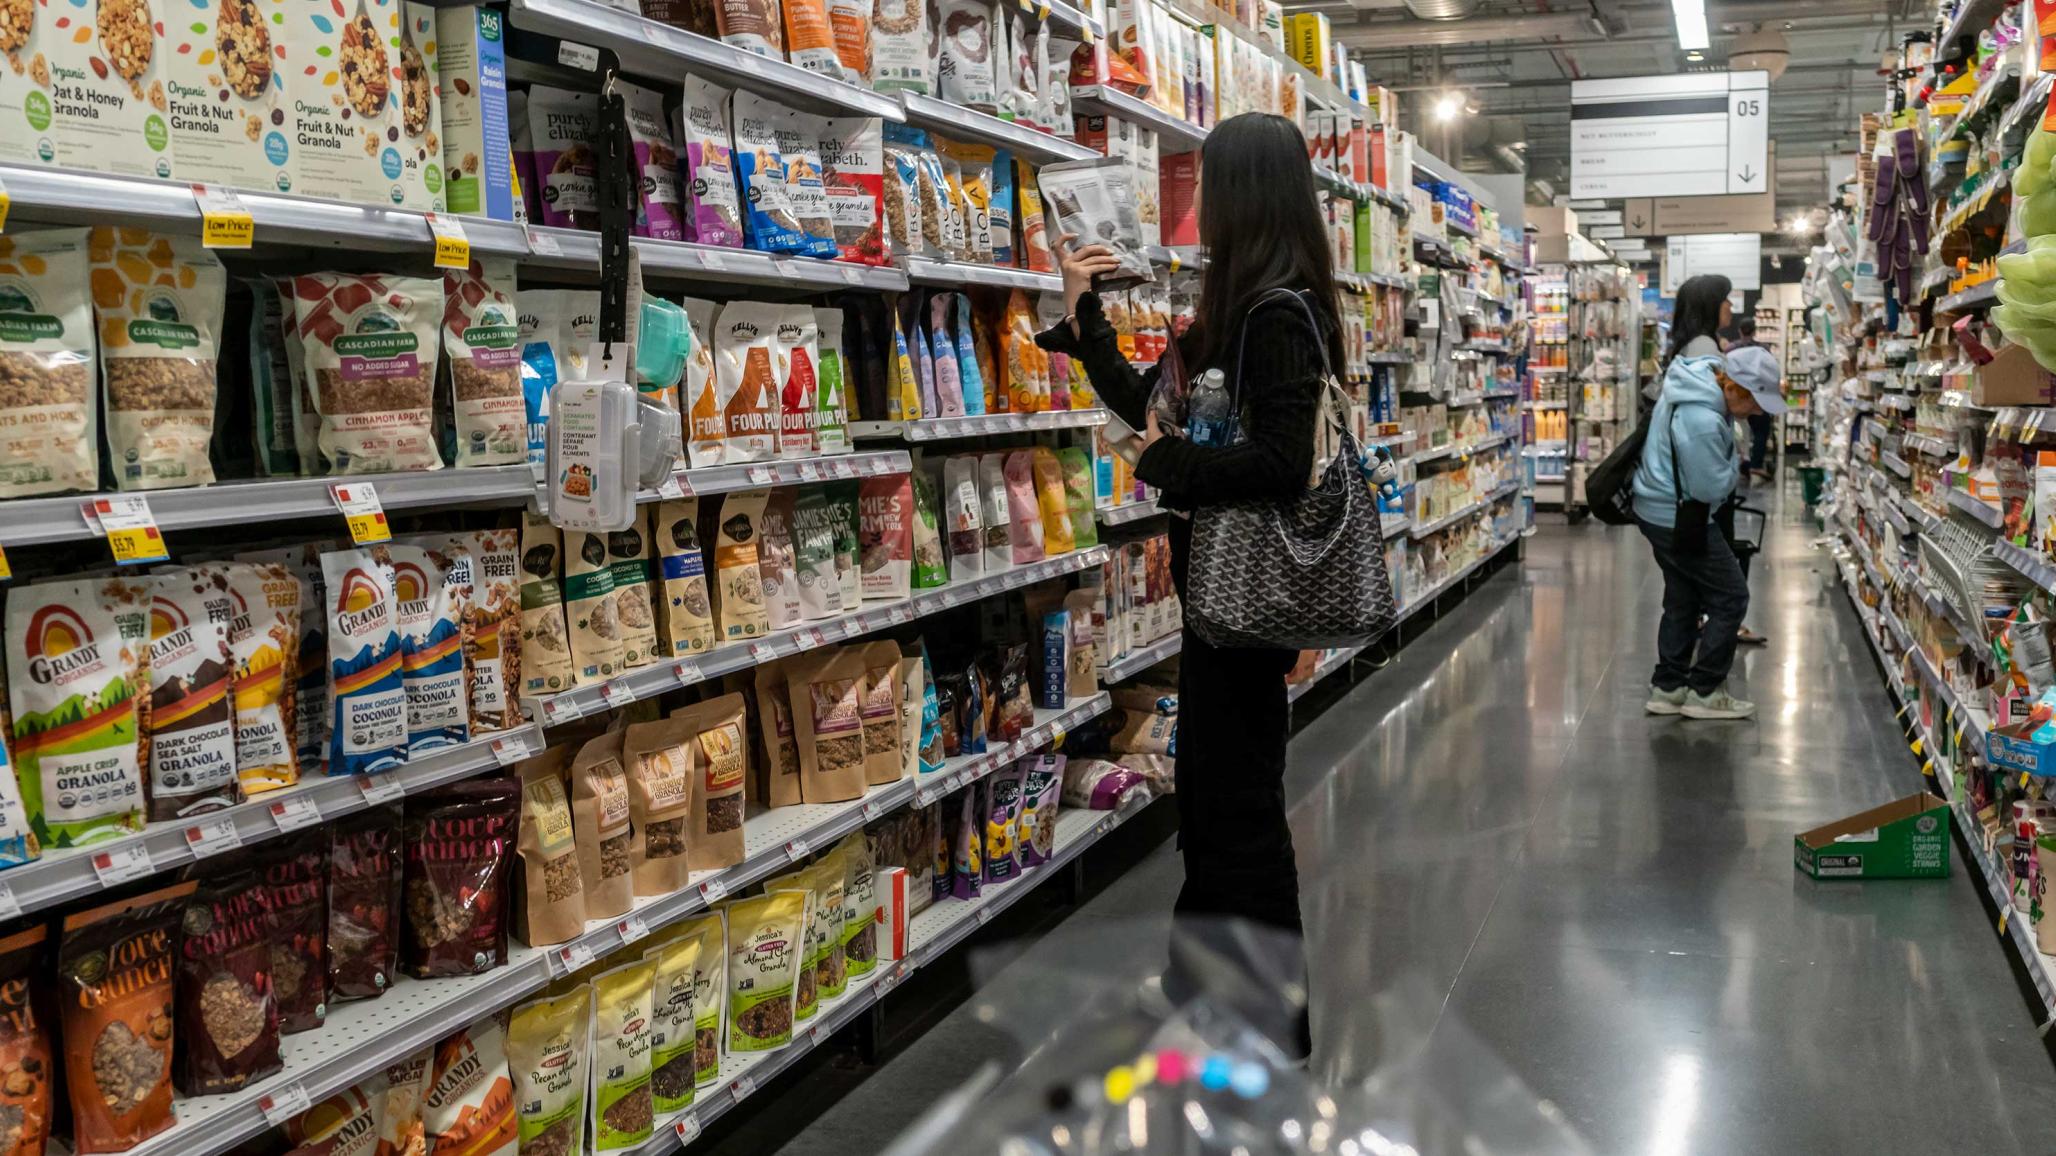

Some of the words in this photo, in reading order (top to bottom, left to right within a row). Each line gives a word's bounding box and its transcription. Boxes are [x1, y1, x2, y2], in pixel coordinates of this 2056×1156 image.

[725, 3, 748, 12] BUTTER
[481, 14, 498, 31] 365
[168, 81, 206, 98] Organic
[75, 87, 84, 101] &
[87, 89, 124, 110] Honey
[170, 101, 199, 117] Fruit
[201, 104, 209, 117] &
[212, 107, 233, 120] Nut
[295, 100, 330, 116] Organic
[690, 106, 712, 121] purely
[1738, 101, 1759, 116] 05
[171, 116, 219, 133] Granola
[297, 119, 324, 134] Fruit
[325, 122, 332, 134] &
[335, 123, 354, 136] Nut
[547, 113, 591, 128] purely
[298, 132, 341, 149] Granola
[819, 138, 846, 152] rely
[836, 201, 869, 215] granola
[969, 186, 990, 244] BOLA
[207, 220, 226, 231] Low
[228, 220, 251, 231] Price
[439, 244, 450, 253] Low
[450, 244, 467, 254] Price
[338, 340, 395, 350] CASCADIAN
[396, 338, 415, 347] FARM
[491, 352, 507, 360] ADDED
[352, 362, 364, 371] NO
[365, 361, 389, 371] ADDED
[391, 360, 410, 369] SUGAR
[483, 400, 519, 410] CINNAMON
[22, 413, 47, 424] AND
[345, 414, 394, 426] CINNAMON
[398, 412, 424, 422] APPLE
[731, 414, 763, 432] FOUR
[783, 413, 803, 430] OUR
[859, 496, 901, 514] MIE'S
[860, 515, 884, 531] RM
[450, 560, 469, 572] RAIN
[481, 555, 515, 565] GRAIN
[484, 564, 515, 577] FREE!
[262, 582, 297, 593] GRAIN
[266, 592, 298, 608] FREE!
[400, 600, 430, 616] RANDY
[114, 613, 145, 624] GLUTEN
[232, 614, 251, 633] NDY
[338, 603, 387, 636] GRANDY
[400, 612, 432, 625] RGANICS
[119, 623, 145, 638] FREE!
[353, 616, 389, 637] ORGANICS
[151, 628, 194, 660] RANDY
[29, 644, 100, 685] GRANDY
[153, 645, 198, 670] ORGANICS
[54, 661, 107, 686] ORGANICS
[474, 666, 492, 675] TTER
[404, 686, 420, 694] ARK
[423, 678, 461, 691] CHOCOLATE
[406, 689, 456, 704] OCONOLA
[352, 703, 373, 712] DARK
[352, 706, 402, 724] COCONOLA
[156, 736, 187, 750] DARK
[188, 727, 230, 744] CHOCOLATE
[157, 748, 178, 759] SEA
[180, 744, 202, 757] SALT
[57, 762, 92, 776] APPLE
[94, 758, 119, 770] CRISP
[160, 751, 223, 772] GRANOLA
[219, 763, 231, 774] 6G
[57, 769, 126, 790] GRANOLA
[1912, 843, 1941, 851] GARDEN
[1821, 858, 1845, 867] ORIGINAL
[1914, 852, 1940, 860] VEGGIE
[1912, 860, 1941, 868] STRAWS
[755, 930, 783, 942] Jessica's
[744, 951, 774, 965] Almond
[760, 957, 786, 972] Granola
[669, 981, 691, 994] Jessica'
[542, 1041, 570, 1056] Jessica'
[532, 1071, 557, 1084] Pecan
[445, 1069, 487, 1106] ORGANICS
[332, 1109, 375, 1148] ANDY
